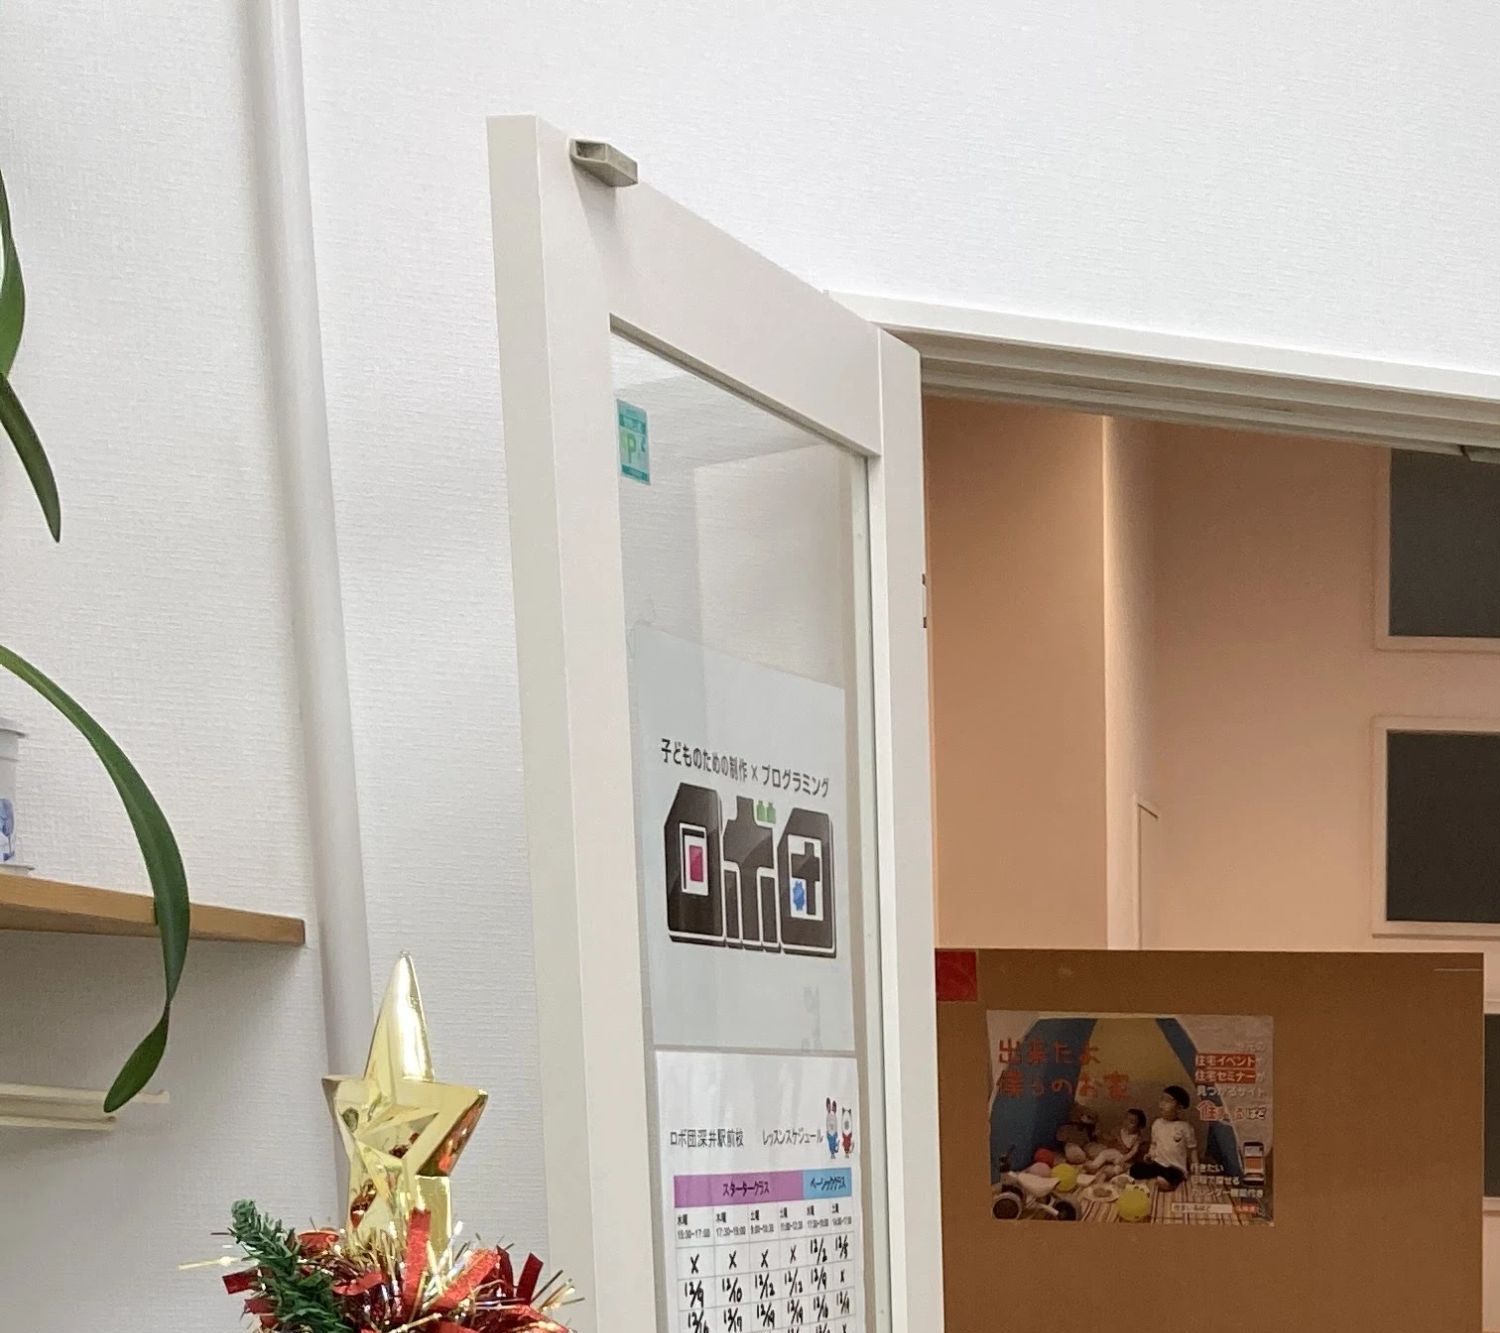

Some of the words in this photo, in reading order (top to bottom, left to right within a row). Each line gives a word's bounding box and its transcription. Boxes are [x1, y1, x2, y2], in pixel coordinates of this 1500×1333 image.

[661, 738, 748, 782] 子どものための制作
[762, 765, 830, 798] プログラミング
[670, 1129, 744, 1148] ロボ団深井駅前校
[762, 1127, 823, 1146] レッスンスケジュール
[722, 1181, 769, 1197] スタータークラス
